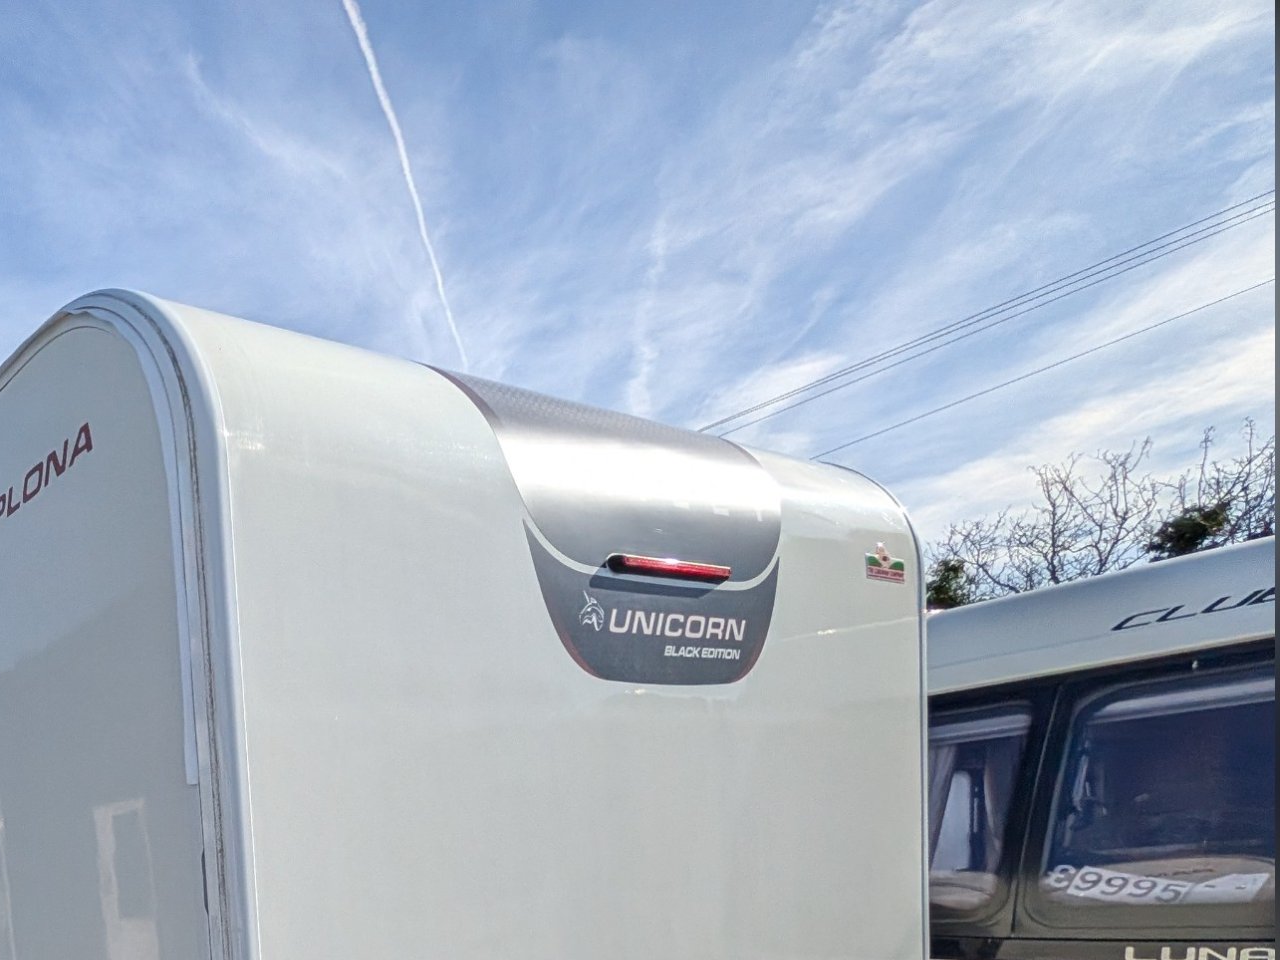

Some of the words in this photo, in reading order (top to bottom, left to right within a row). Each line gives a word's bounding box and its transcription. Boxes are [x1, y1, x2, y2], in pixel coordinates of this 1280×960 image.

[609, 608, 746, 641] UNICORN
[664, 645, 700, 658] BLACK
[701, 647, 740, 660] EDITION
